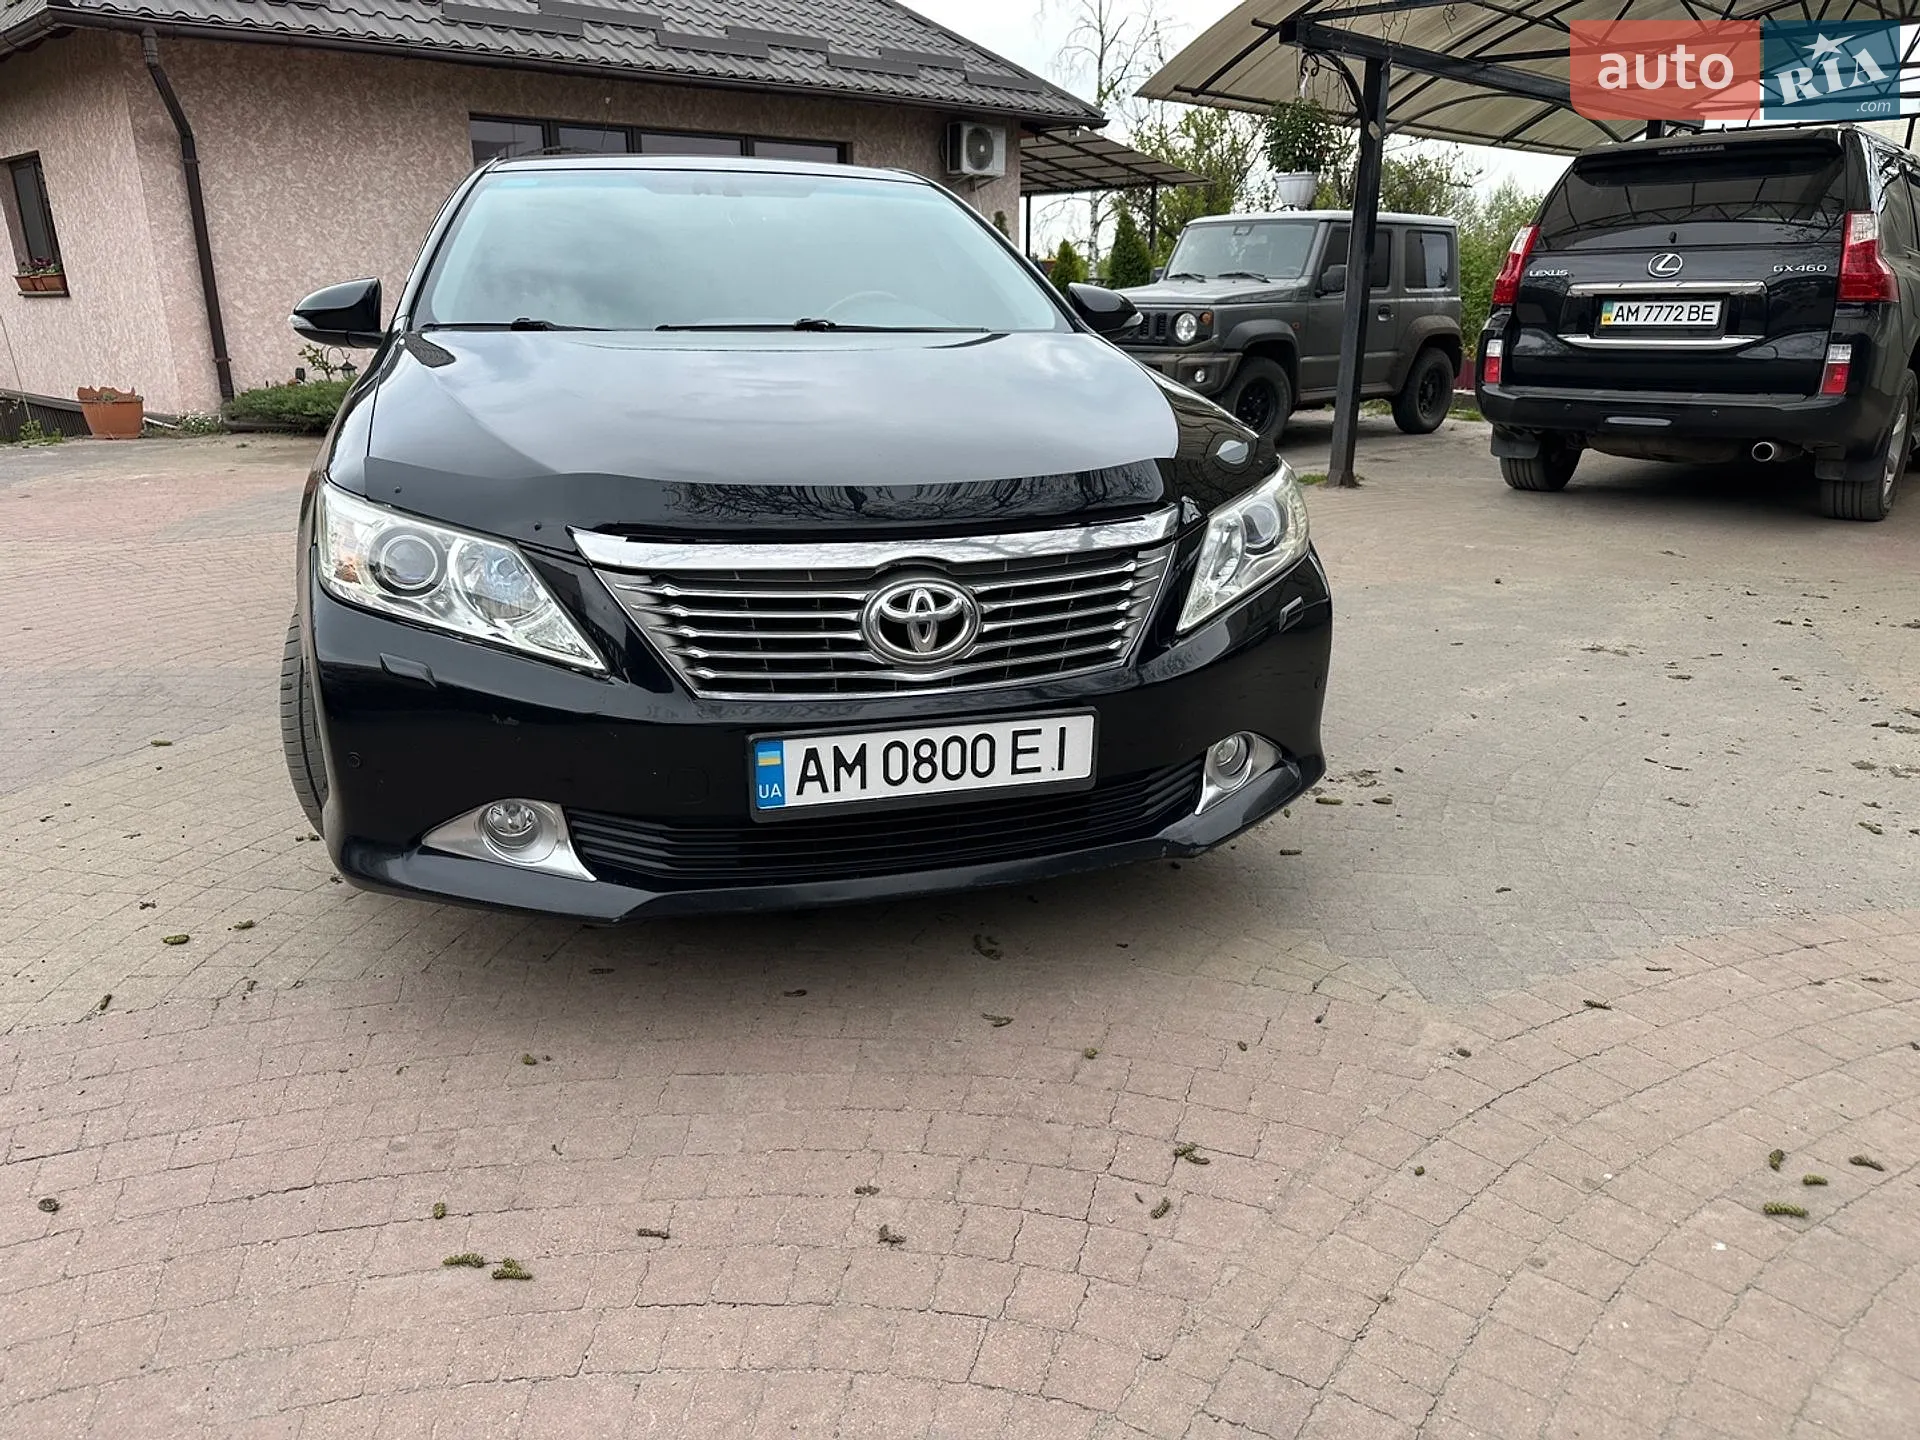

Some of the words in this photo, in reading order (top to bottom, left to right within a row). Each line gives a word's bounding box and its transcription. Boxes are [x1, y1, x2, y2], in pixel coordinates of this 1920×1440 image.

[1529, 269, 1568, 277] LEXUS
[1614, 305, 1640, 322] AM
[1643, 305, 1685, 322] 7772
[1687, 305, 1716, 321] BE
[796, 742, 868, 796] AM
[882, 733, 996, 787] 0800
[758, 783, 782, 799] UA
